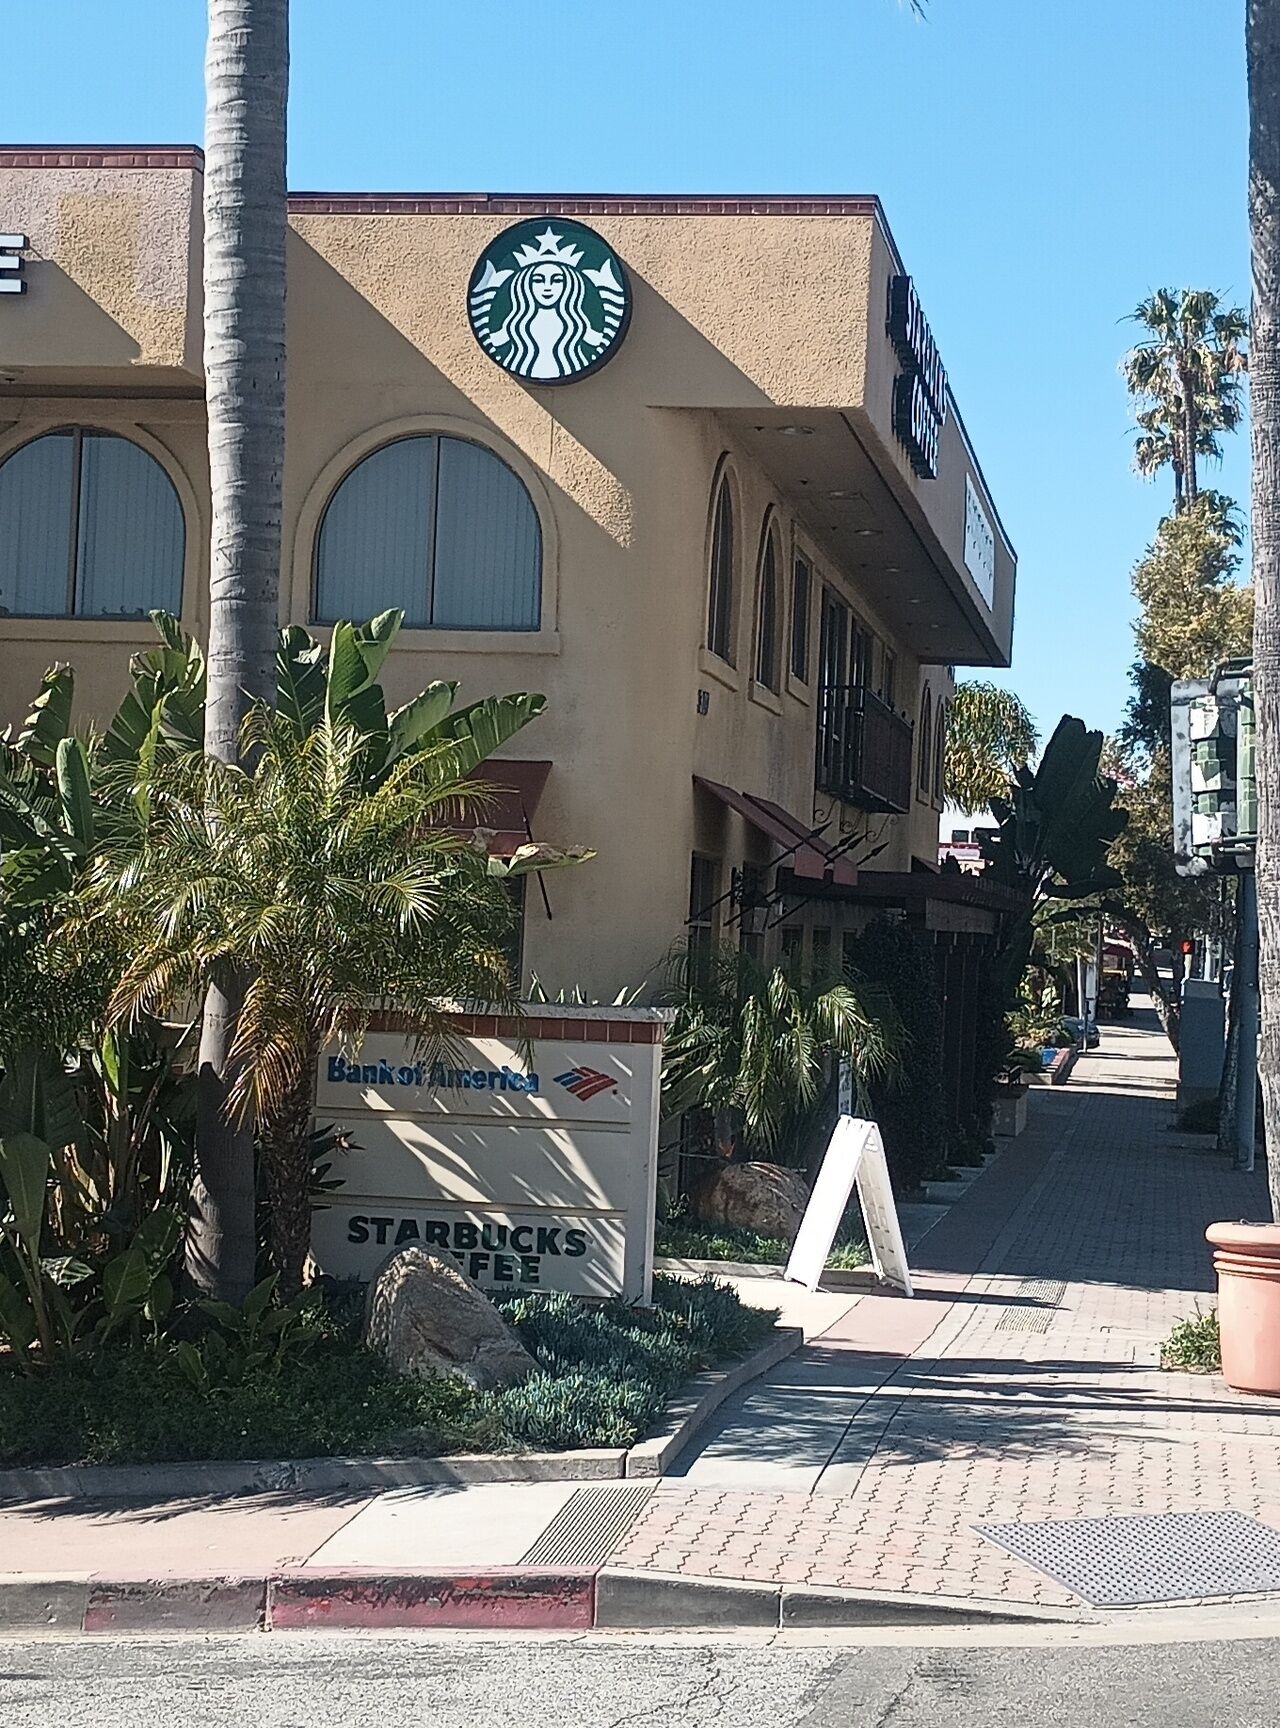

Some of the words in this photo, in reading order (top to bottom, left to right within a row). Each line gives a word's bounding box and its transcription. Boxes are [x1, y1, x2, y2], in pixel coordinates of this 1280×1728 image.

[327, 1056, 394, 1086] Bank
[429, 1063, 540, 1093] America
[347, 1215, 587, 1257] STARBUCKS
[456, 1251, 541, 1284] FEE
